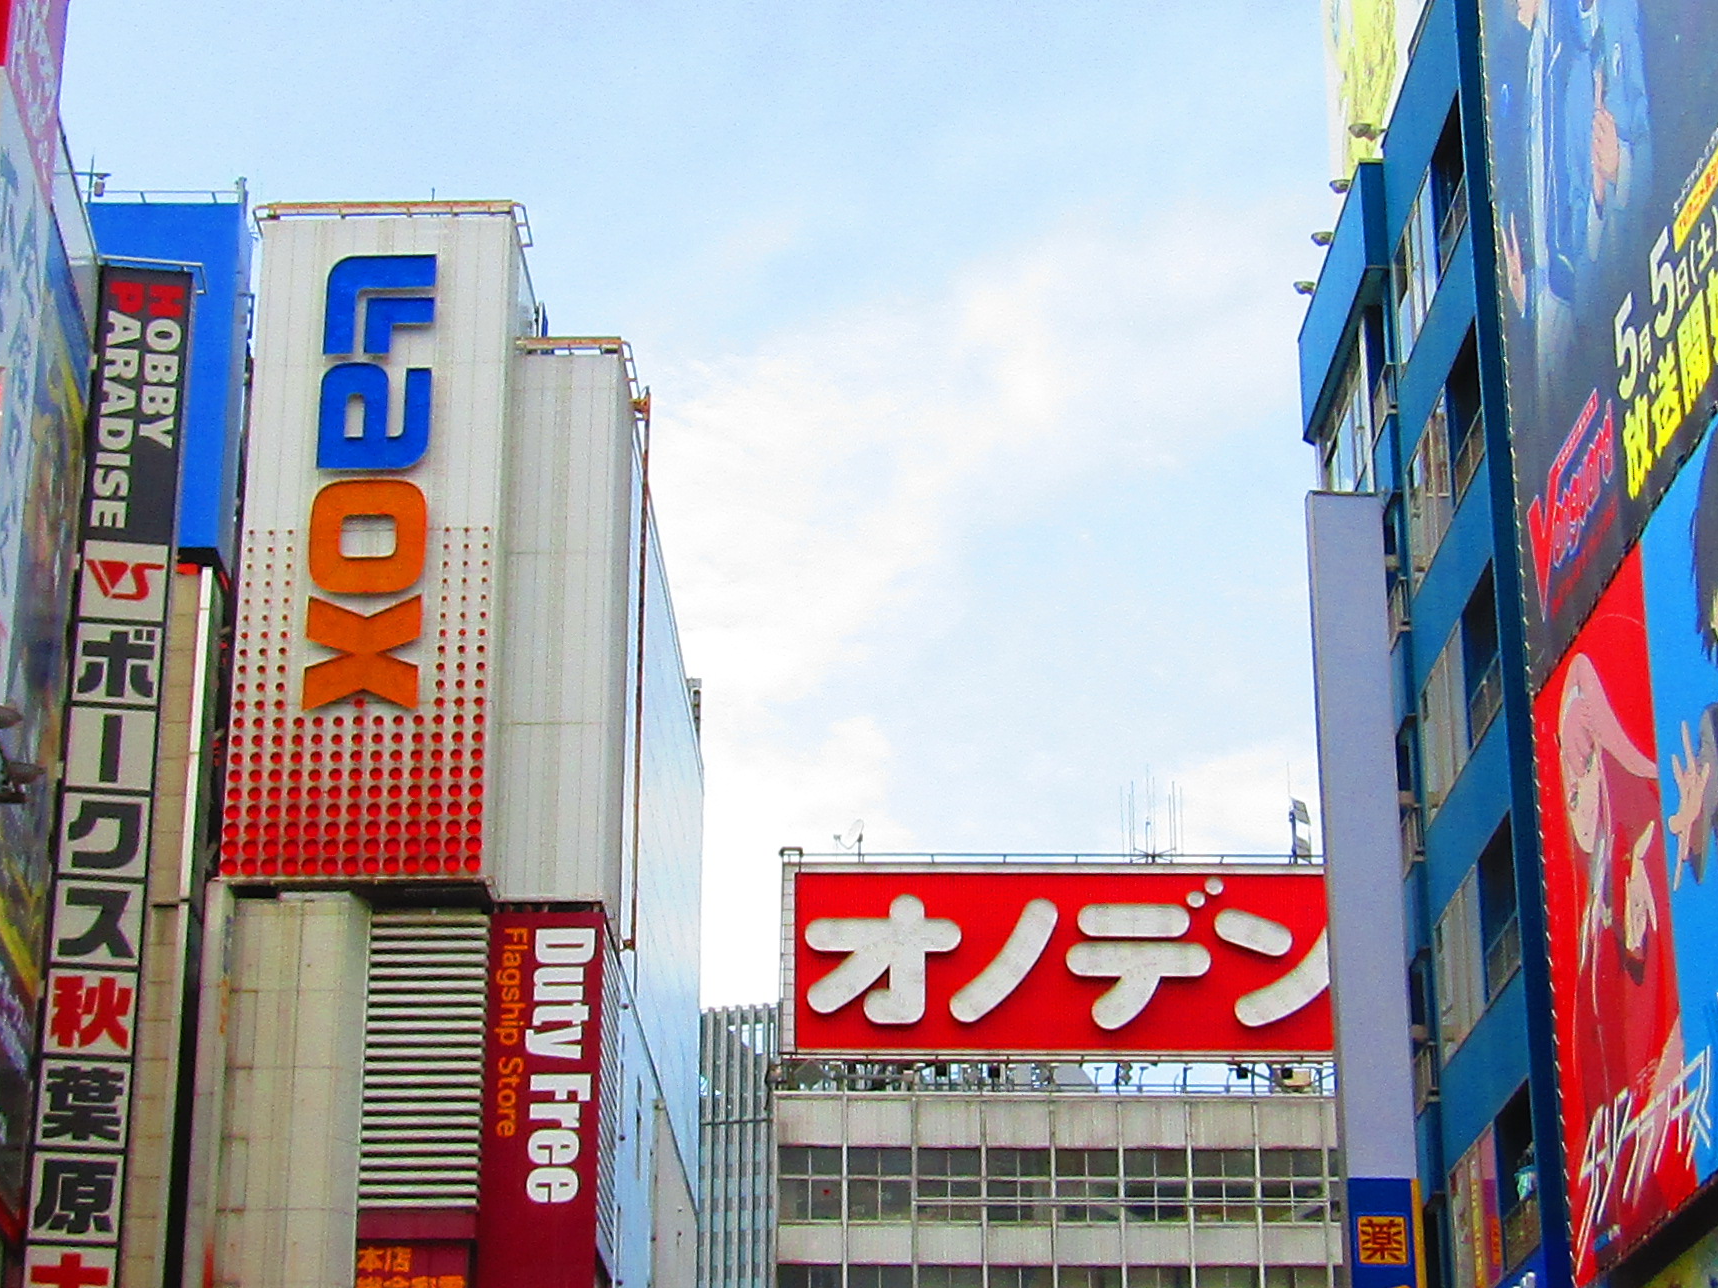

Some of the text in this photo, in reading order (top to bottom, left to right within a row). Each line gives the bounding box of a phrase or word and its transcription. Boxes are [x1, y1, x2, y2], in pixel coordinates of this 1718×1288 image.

[89, 279, 143, 530] PARADISE
[140, 280, 183, 450] HOBBY
[494, 926, 528, 1138] Flagship Store
[805, 876, 1330, 1031] オノデン
[525, 927, 595, 1204] Duty Free
[1360, 1217, 1408, 1264] 薬
